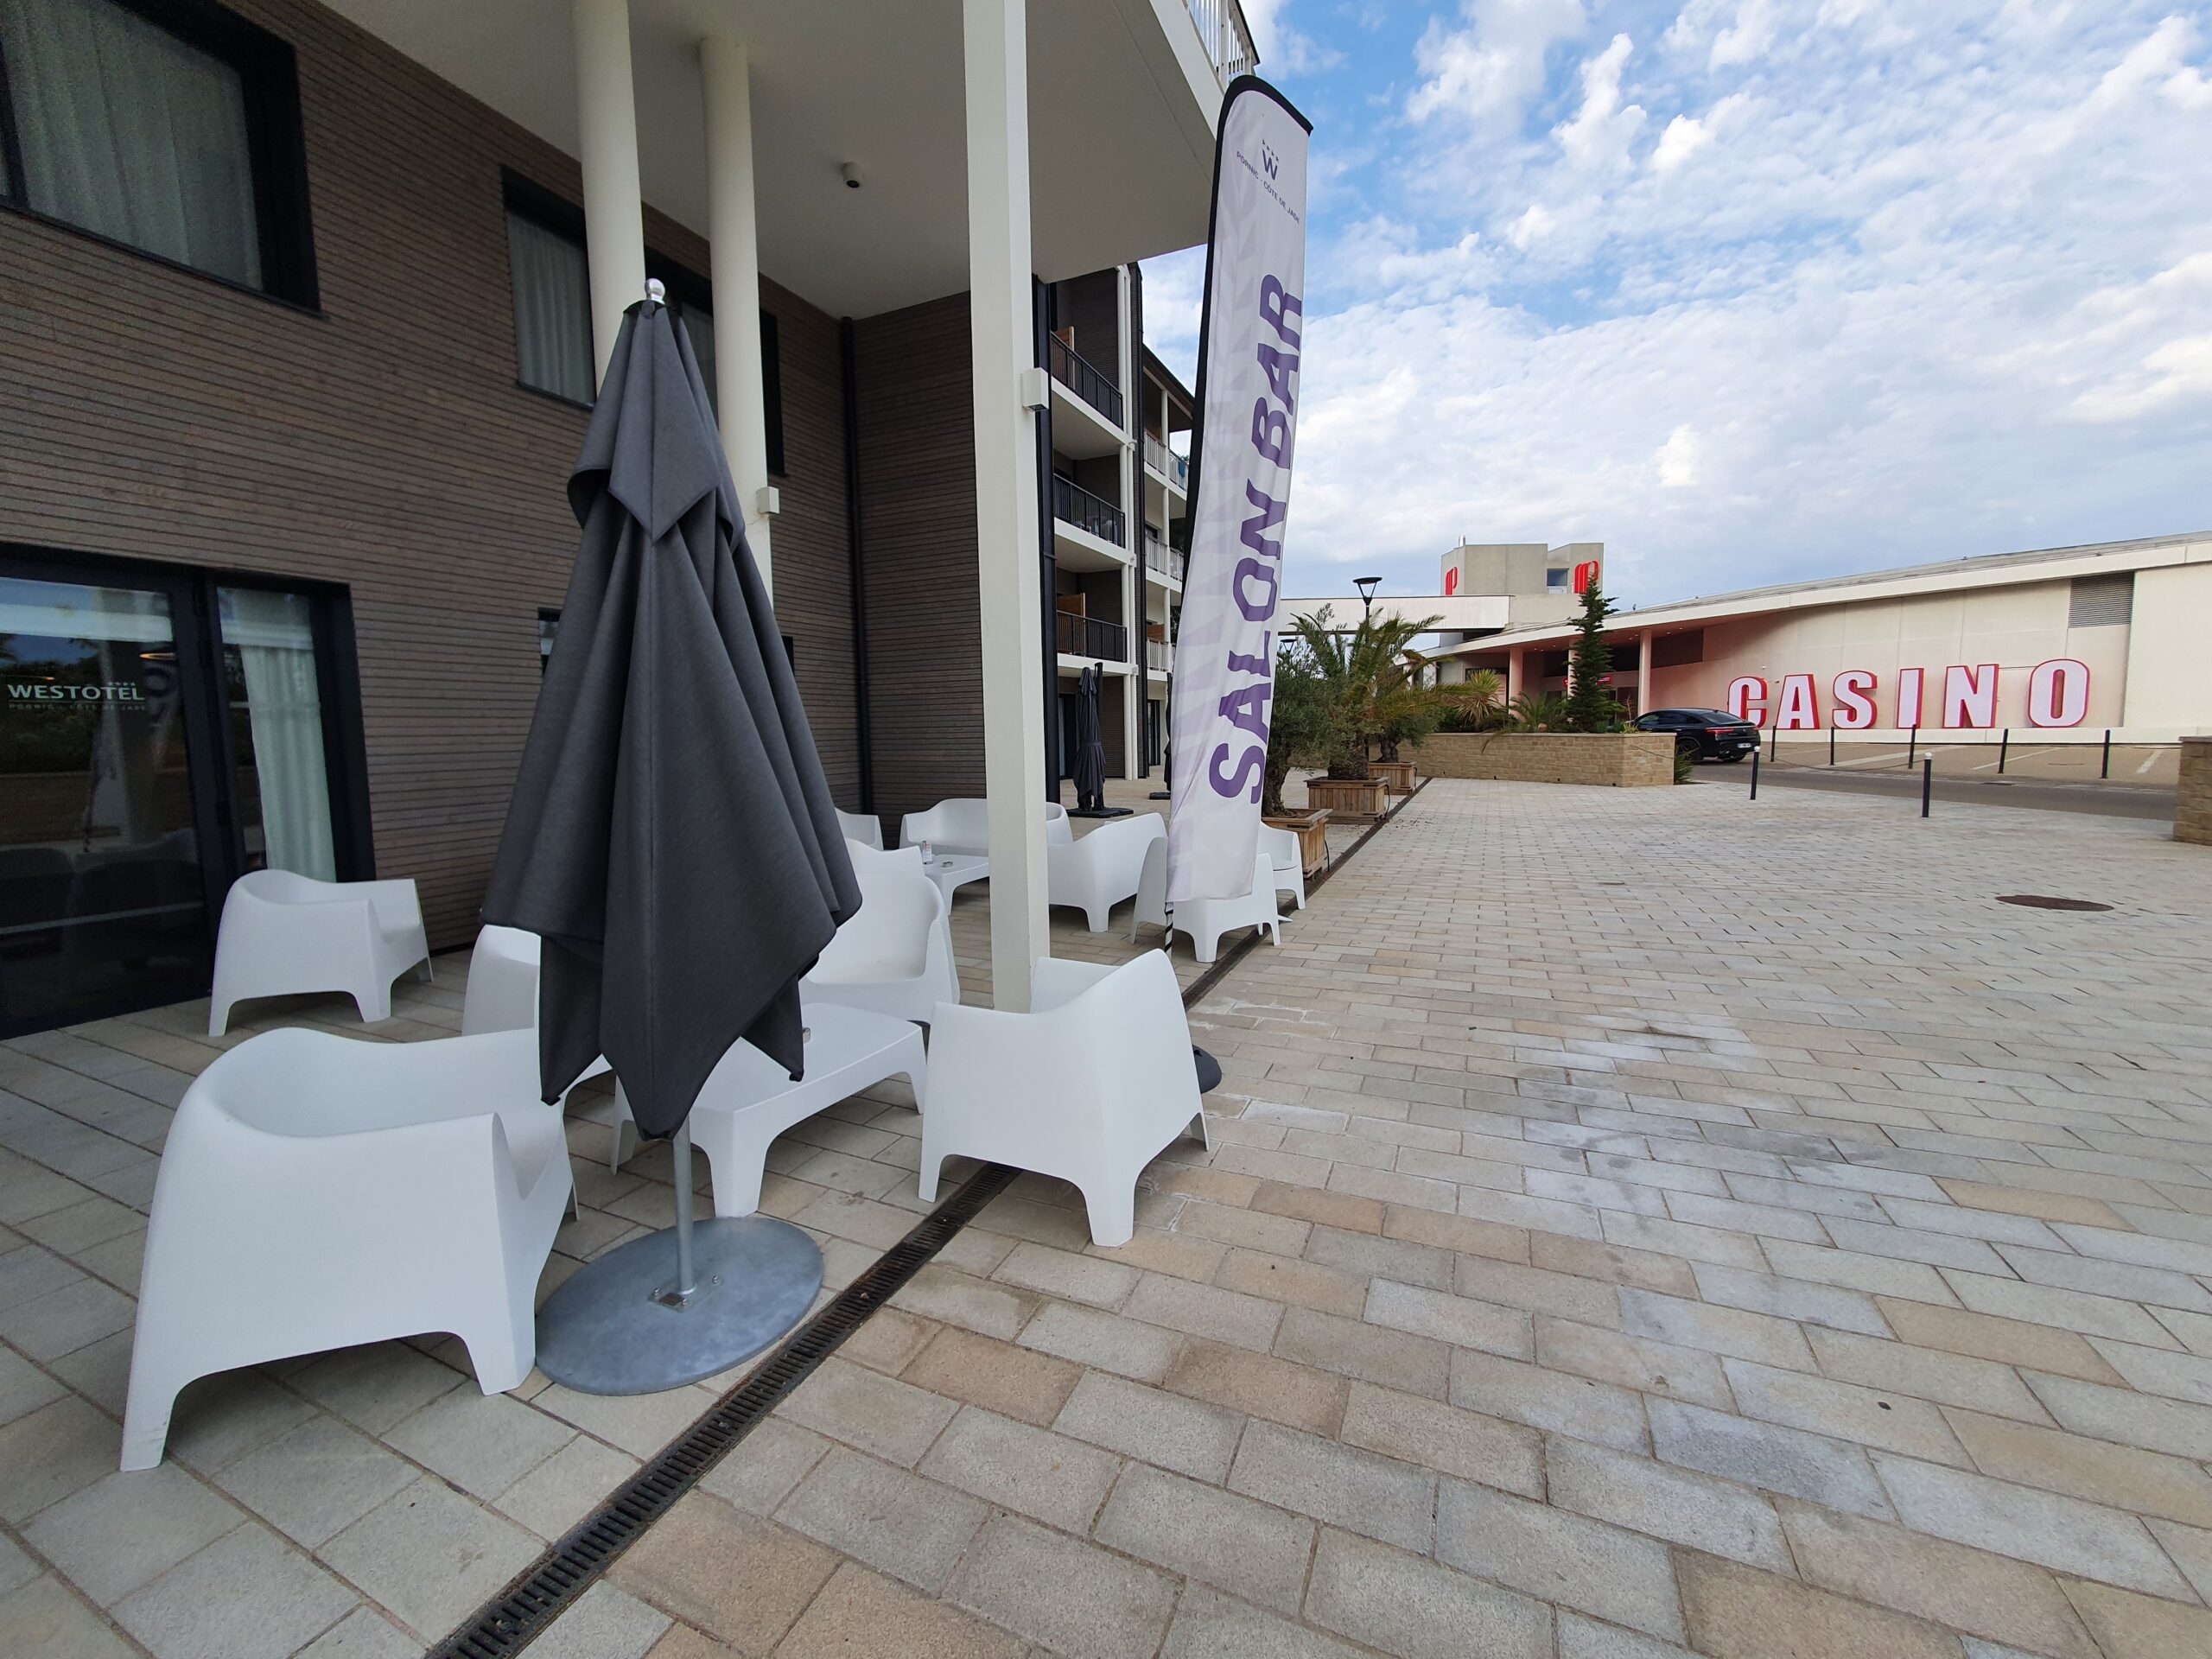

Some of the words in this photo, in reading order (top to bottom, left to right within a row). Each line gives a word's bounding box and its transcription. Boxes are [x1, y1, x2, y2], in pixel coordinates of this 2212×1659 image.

[1236, 150, 1259, 179] PORNIC
[1279, 196, 1287, 210] DE
[1287, 207, 1300, 225] JADE
[1262, 149, 1278, 181] W
[1210, 478, 1287, 804] SALON
[1251, 274, 1302, 470] BAR
[7, 683, 145, 701] WESTOTEL
[1728, 658, 2091, 730] CASINO
